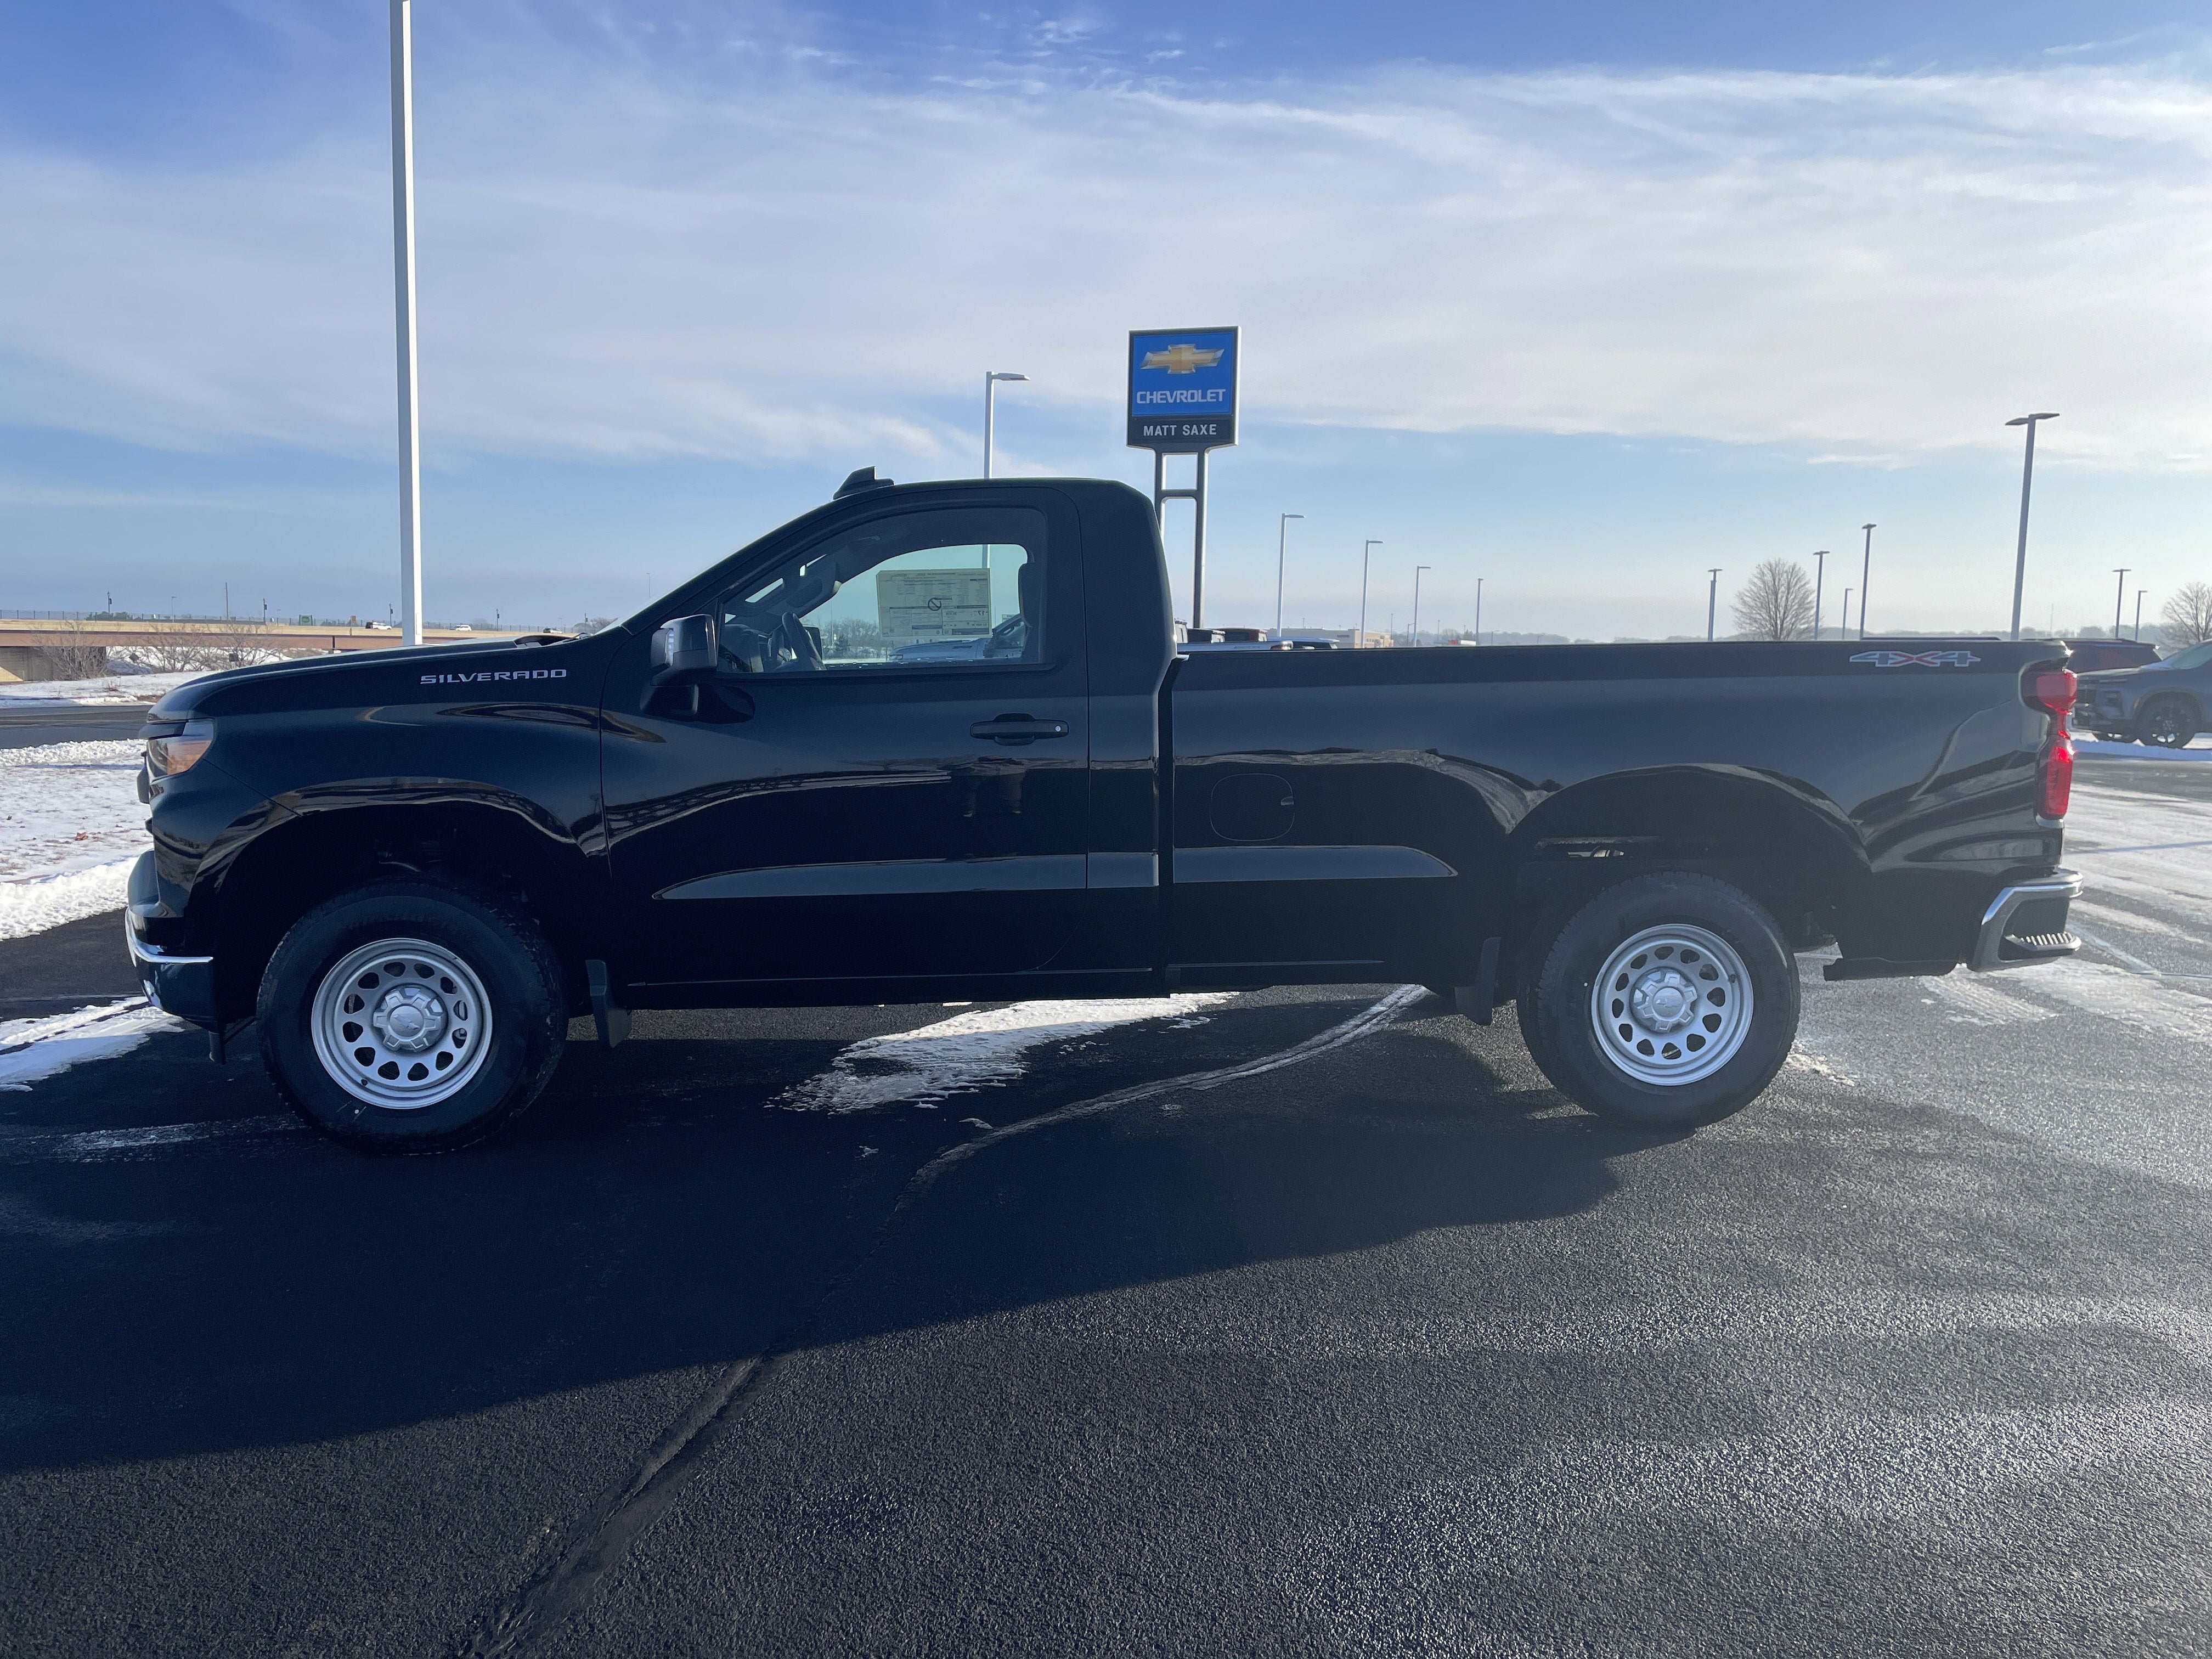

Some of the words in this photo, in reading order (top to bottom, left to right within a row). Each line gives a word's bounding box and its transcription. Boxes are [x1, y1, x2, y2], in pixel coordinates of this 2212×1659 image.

[1137, 389, 1226, 404] CHEVROLET
[1143, 425, 1177, 436] MATT
[1182, 424, 1217, 436] SAXE
[420, 669, 567, 684] SILVERADO
